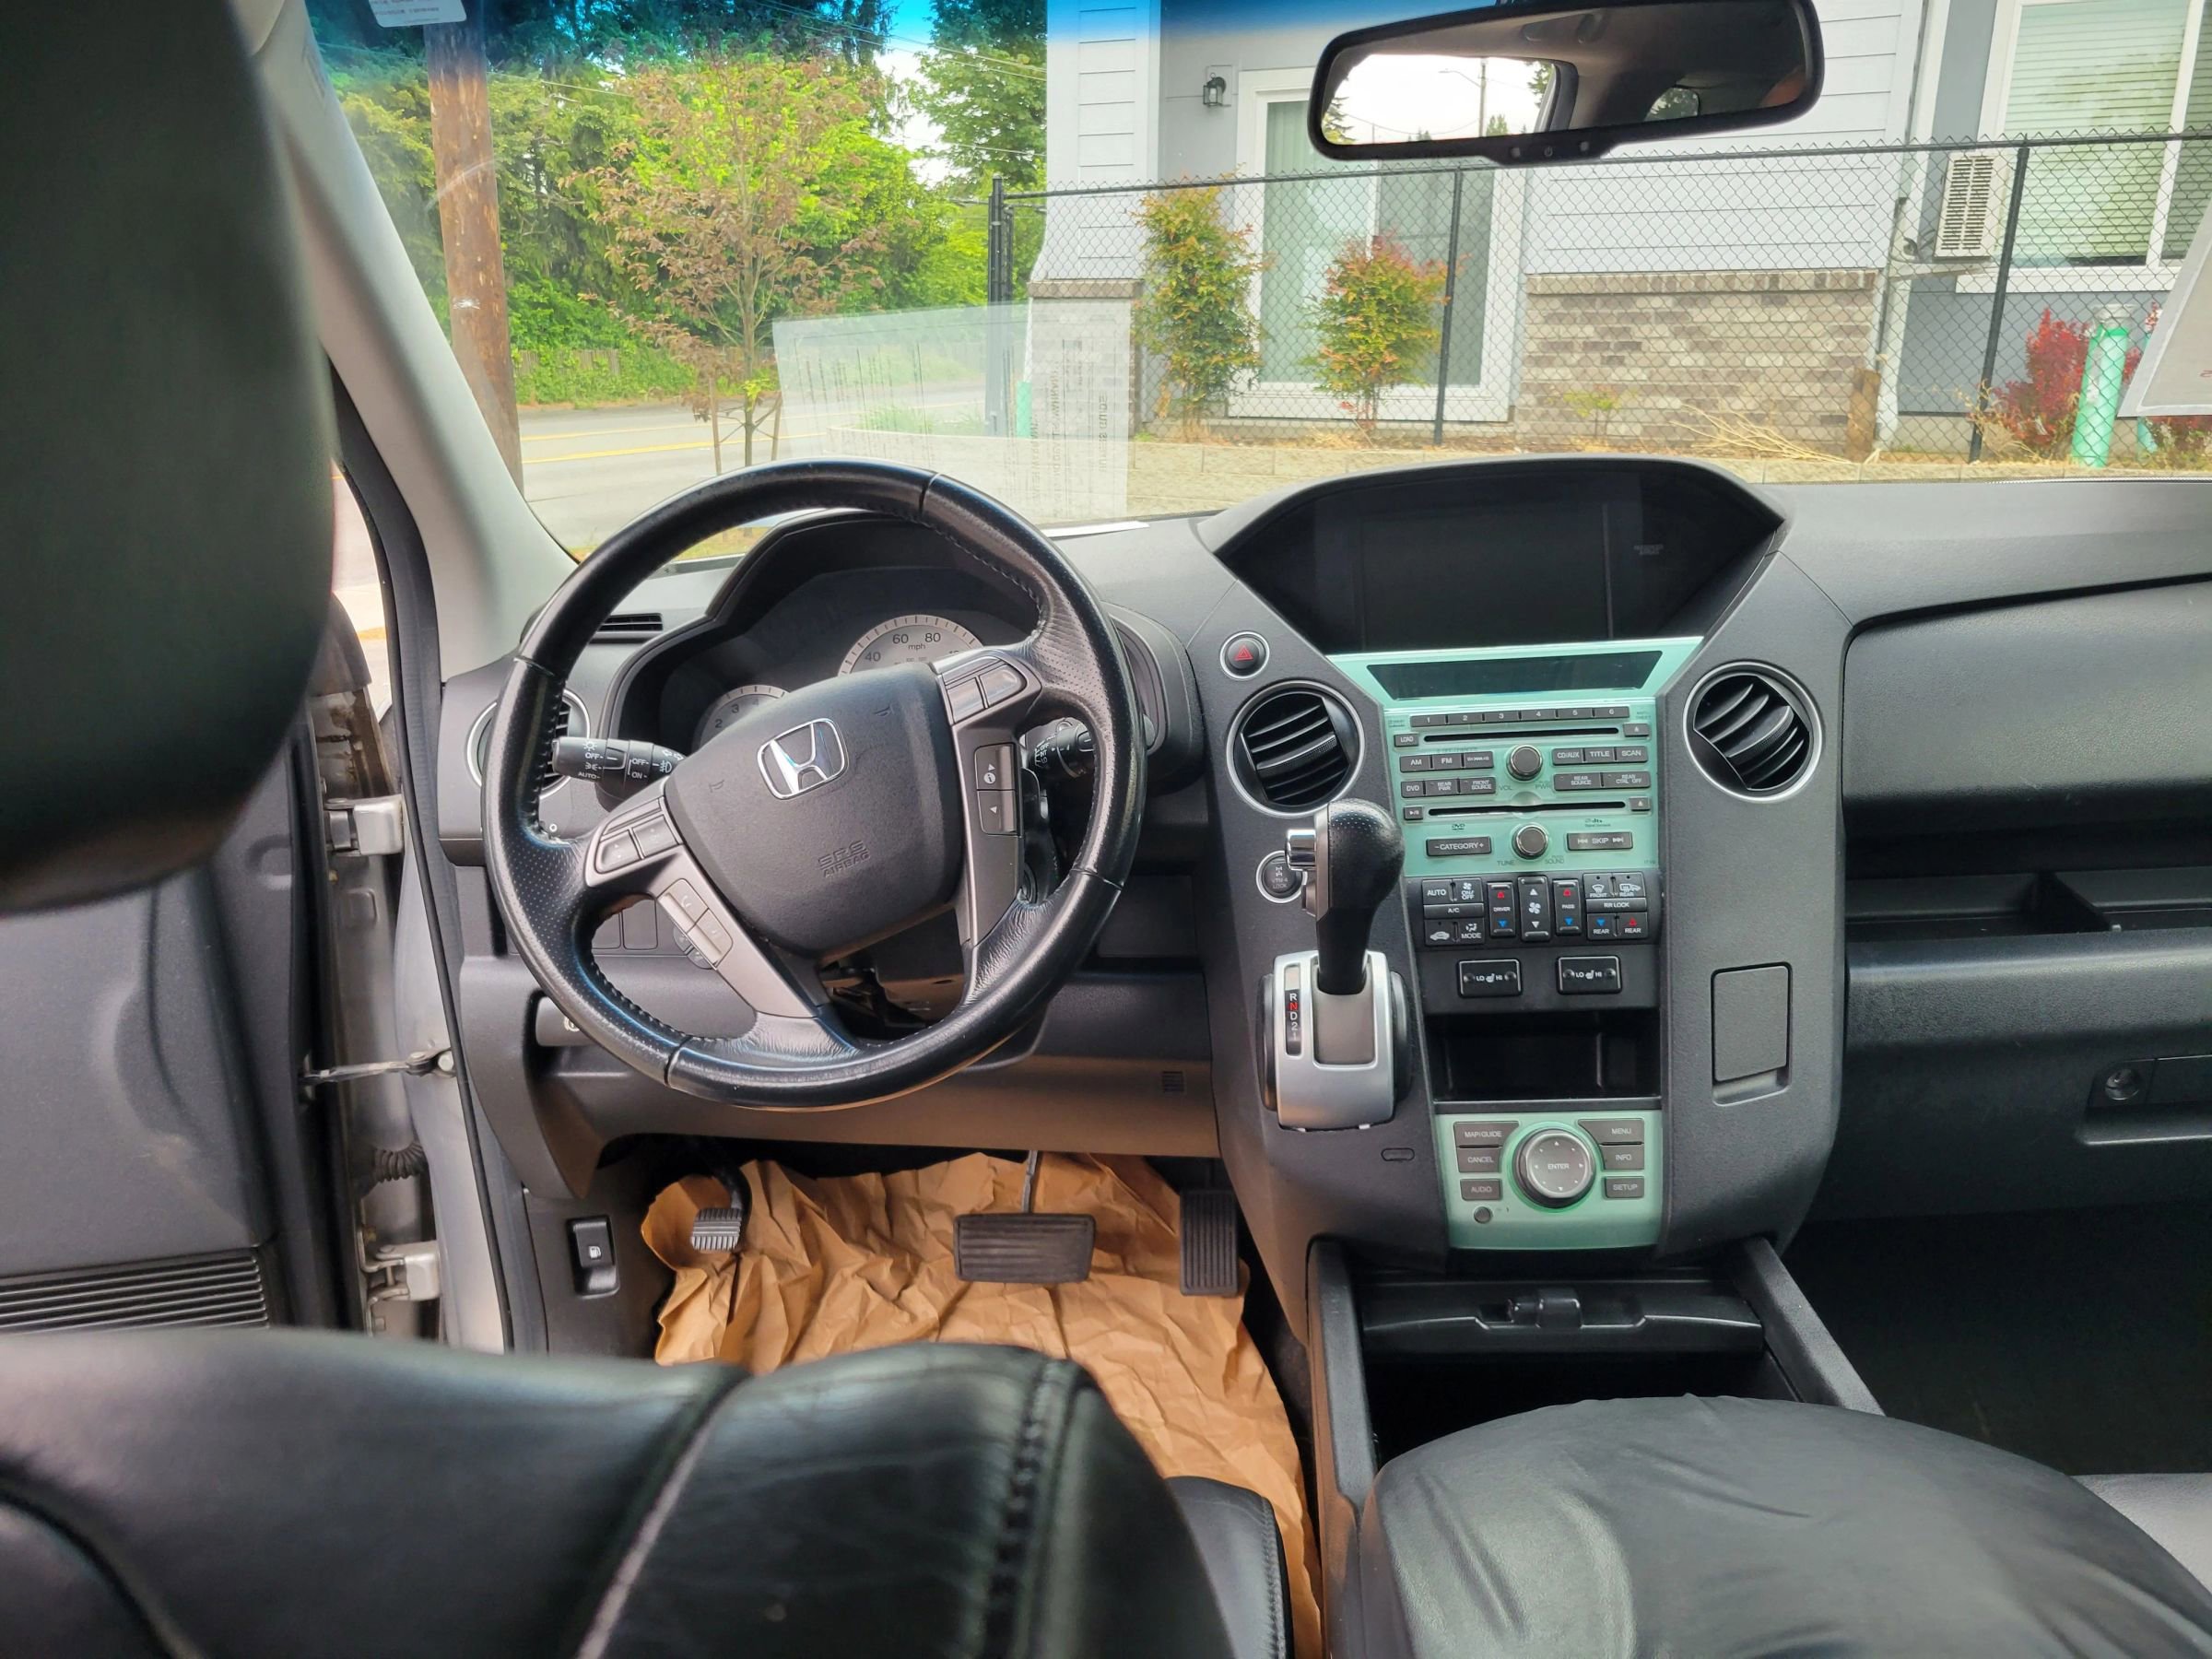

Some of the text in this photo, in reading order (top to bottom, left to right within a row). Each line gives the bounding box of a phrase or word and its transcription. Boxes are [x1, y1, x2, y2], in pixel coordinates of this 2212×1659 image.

[892, 632, 941, 644] 60 80
[865, 652, 881, 662] 40
[731, 704, 739, 713] 3
[715, 719, 723, 728] 2
[578, 771, 596, 780] AUTO
[1289, 993, 1298, 1001] R
[1289, 1002, 1298, 1011] N
[1290, 1012, 1298, 1020] D
[1291, 1021, 1299, 1031] 2
[1611, 1127, 1631, 1135] MENU
[1467, 1156, 1494, 1164] CANCEL
[1613, 1183, 1639, 1192] SETUP
